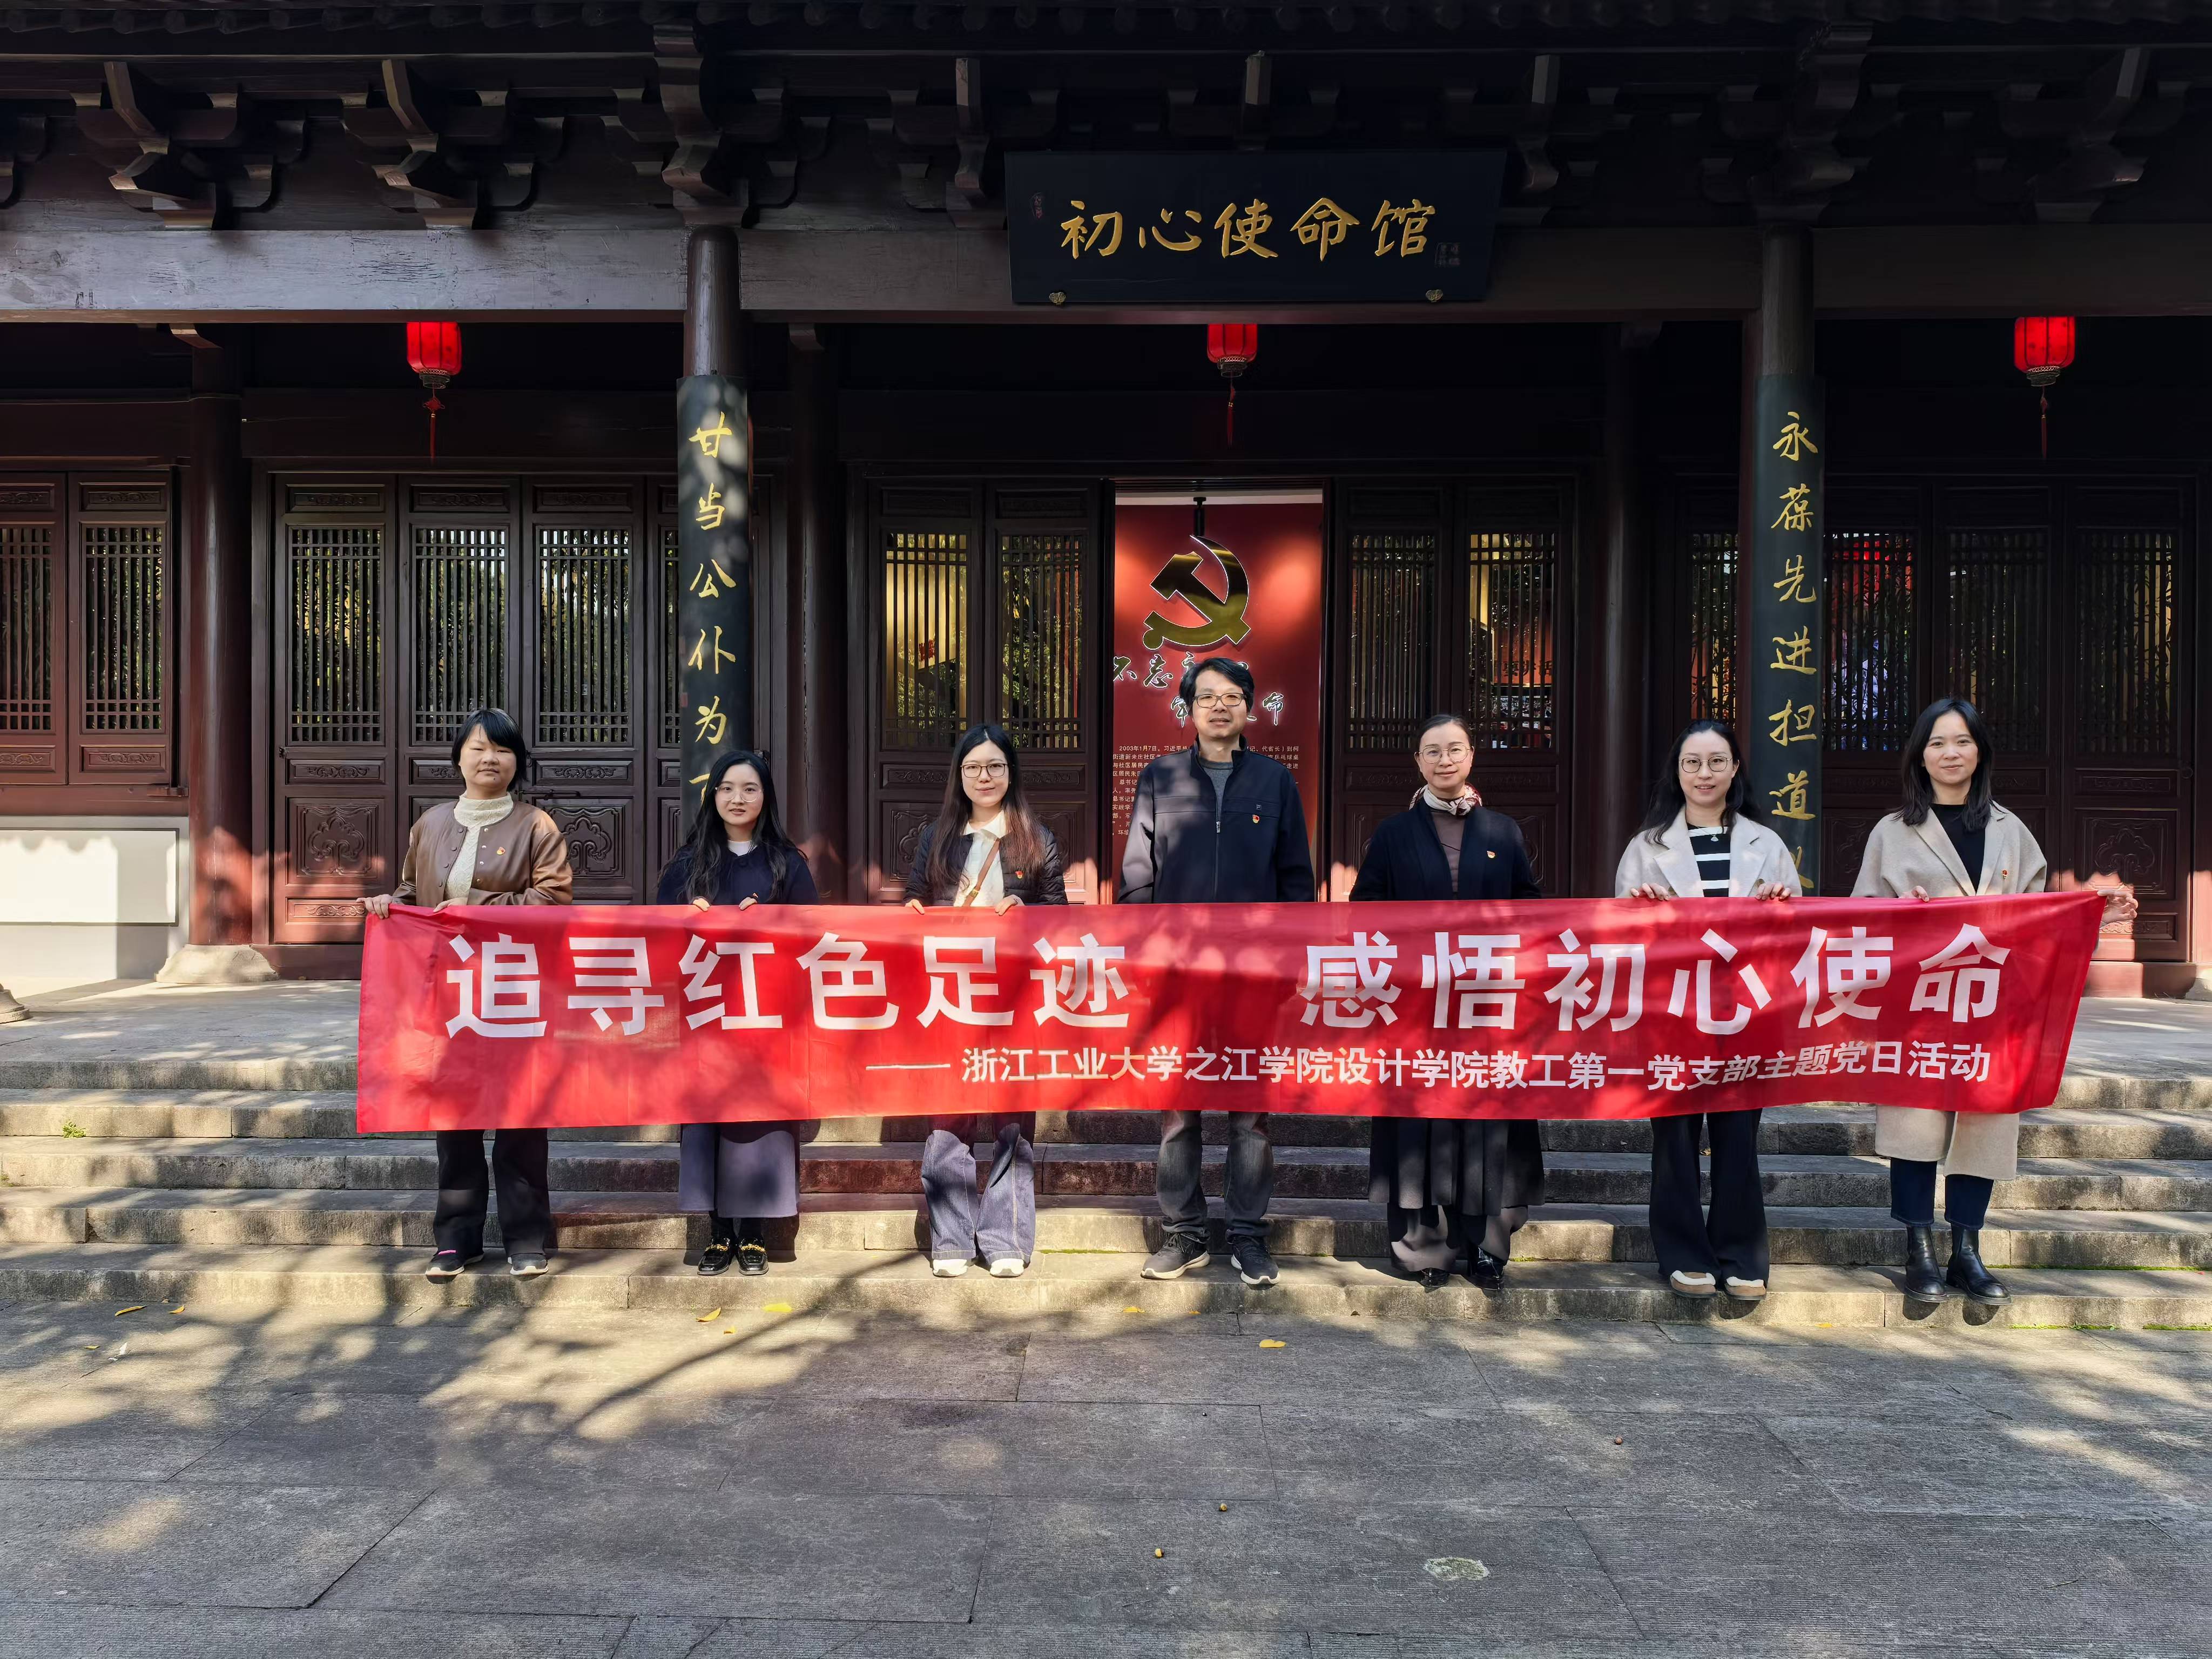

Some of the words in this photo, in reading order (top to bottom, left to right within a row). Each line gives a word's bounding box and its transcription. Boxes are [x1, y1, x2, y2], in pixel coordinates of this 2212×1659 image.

[1060, 197, 1436, 261] 初心使命馆
[688, 410, 737, 808] 甘当公仆为
[444, 932, 1129, 1039] 追寻红色足迹
[1300, 922, 2011, 1035] 感悟初心使命
